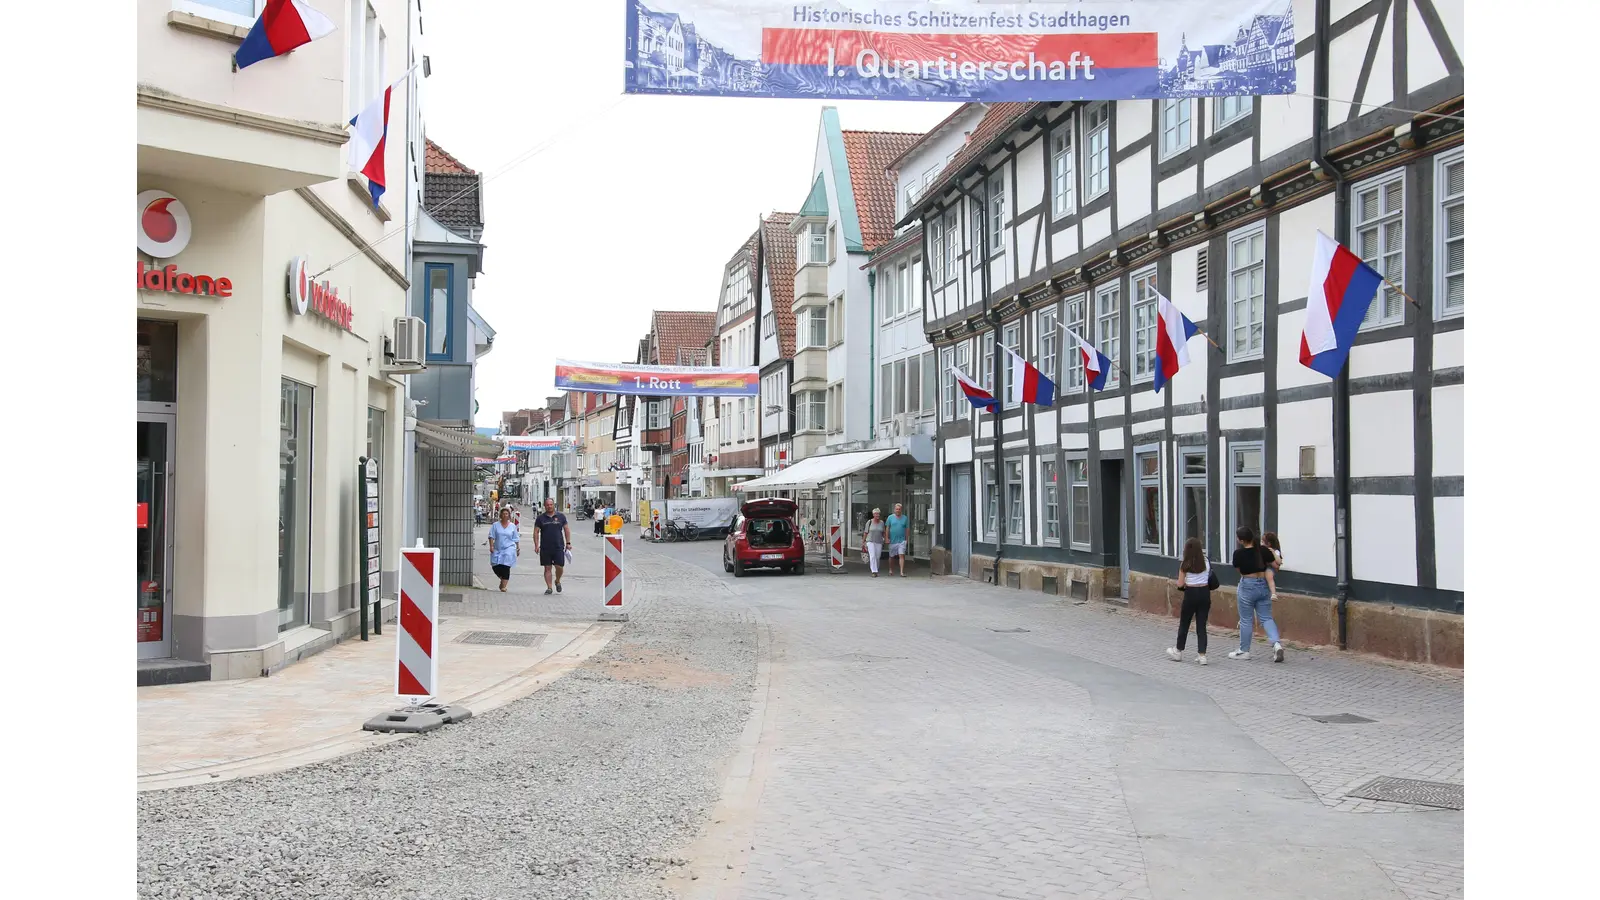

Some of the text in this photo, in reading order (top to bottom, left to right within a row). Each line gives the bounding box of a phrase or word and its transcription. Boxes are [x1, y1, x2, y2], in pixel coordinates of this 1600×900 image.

[793, 5, 1130, 31] Historisches Schützenfest Stadthagen
[856, 48, 1095, 82] Quartierschaft
[311, 279, 353, 332] vodafone
[633, 376, 681, 390] 1. Rott
